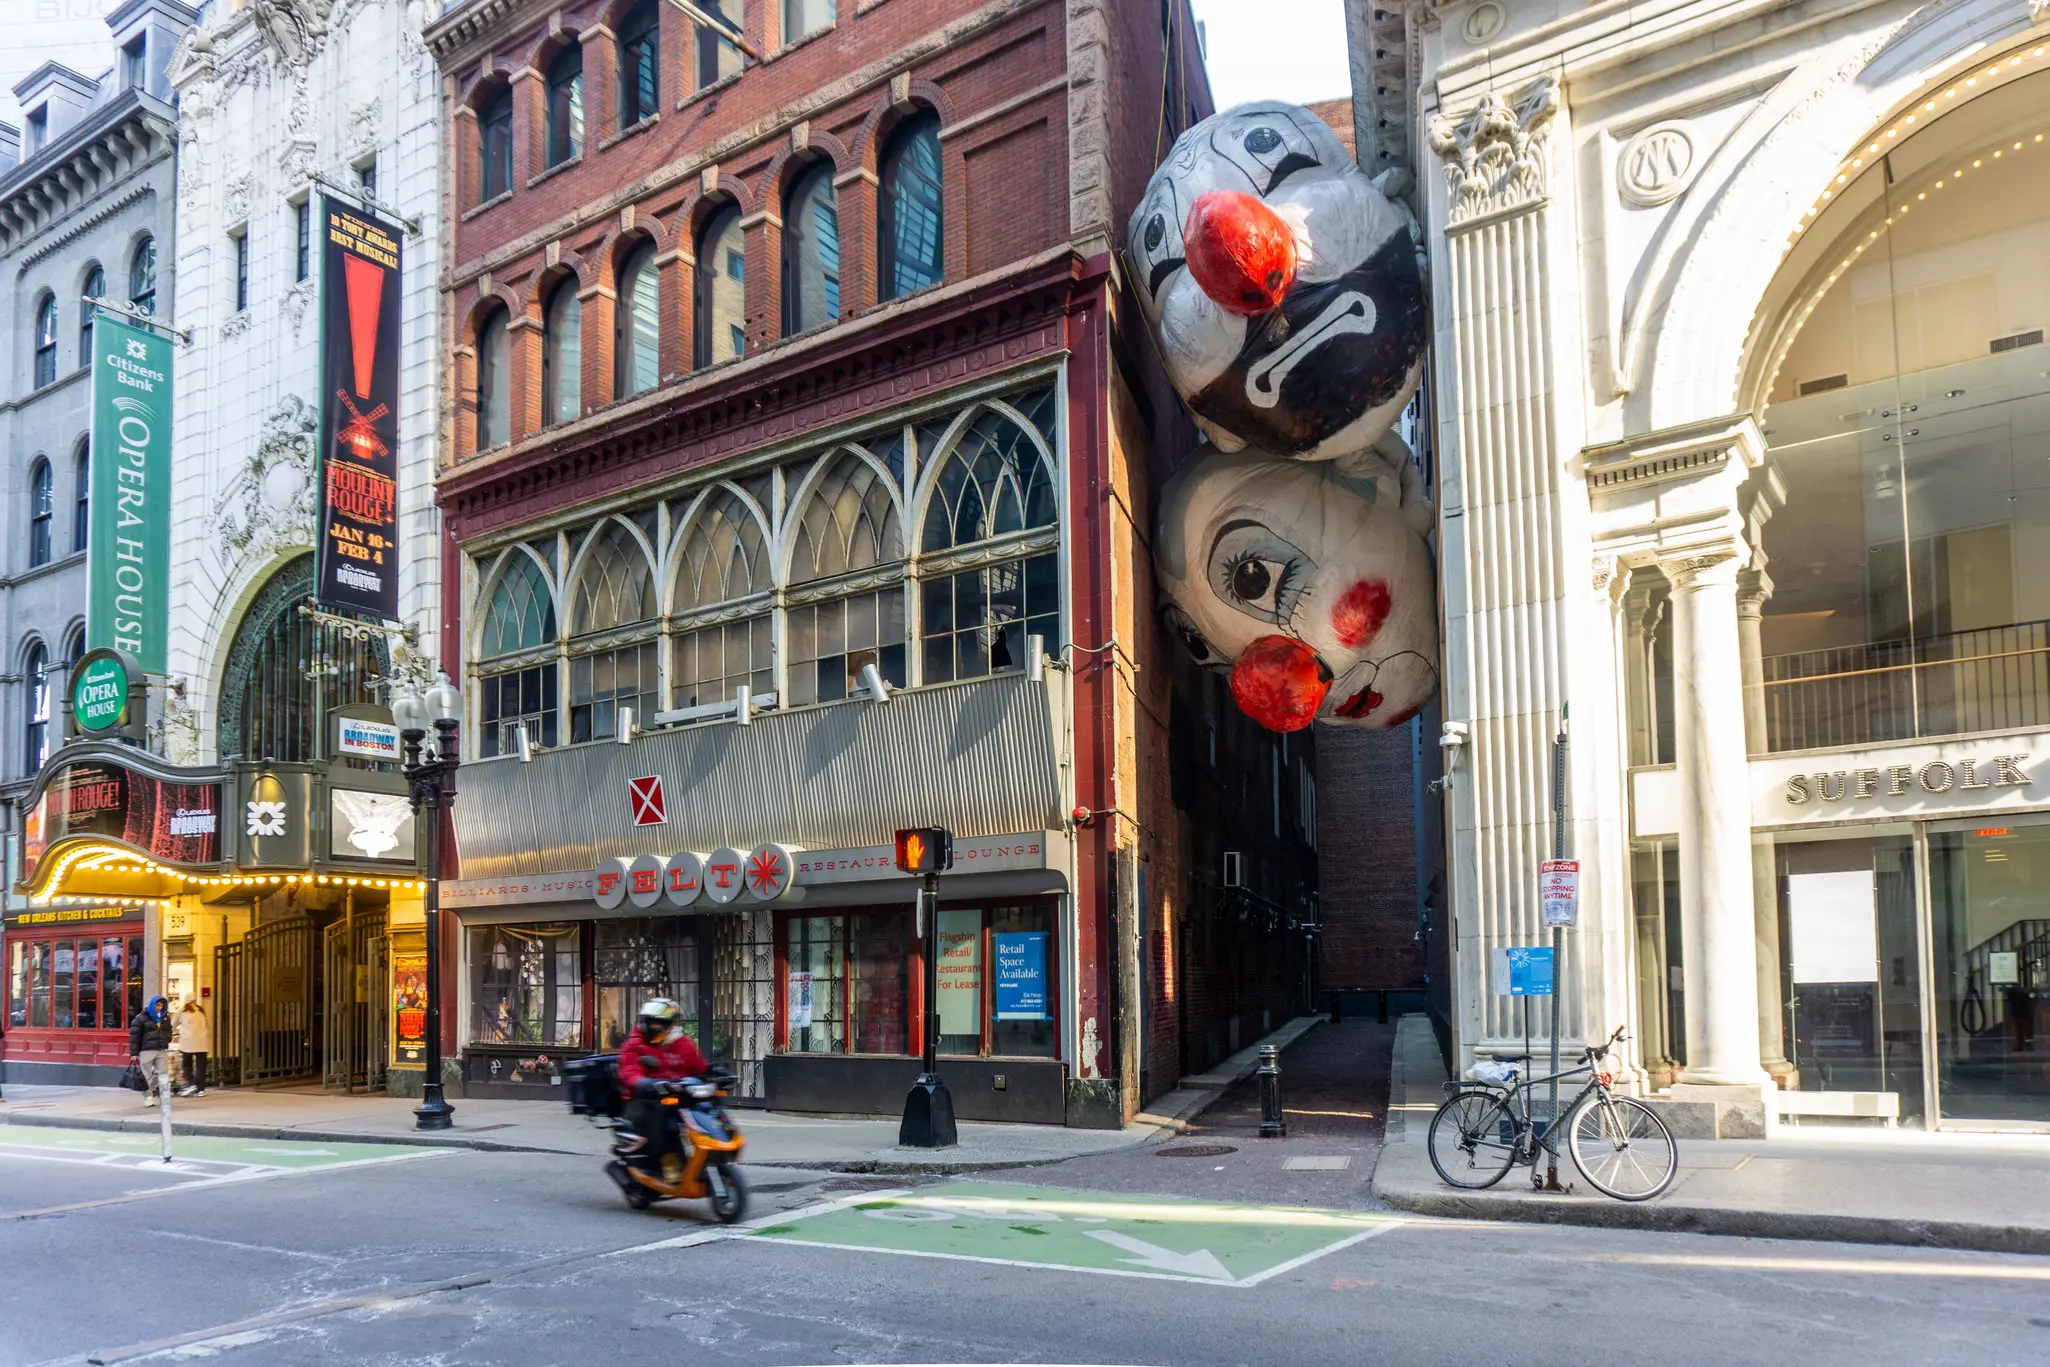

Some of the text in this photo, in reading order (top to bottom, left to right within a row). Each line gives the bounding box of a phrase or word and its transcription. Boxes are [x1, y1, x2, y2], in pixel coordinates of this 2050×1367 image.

[329, 213, 398, 254] 10 TONY AWARDS
[329, 228, 399, 270] BEST MUSICAL!
[107, 354, 164, 382] Citizens
[117, 370, 154, 393] Bank
[327, 464, 386, 502] MOULIN
[114, 415, 151, 654] OPERA HOUSE
[330, 523, 364, 543] JAN
[337, 540, 384, 565] FEB 4
[82, 682, 119, 704] OPERA
[87, 701, 116, 718] HOUSE
[344, 729, 396, 745] BROADWAY
[344, 738, 395, 752] IN BOSTON
[1786, 753, 2033, 805] SUFFOLK
[78, 782, 120, 811] ROUGE!
[800, 844, 1041, 873] RESTAUR LOUNGE
[442, 880, 594, 898] BILLIARDS MUSIC
[596, 863, 737, 896] FELT
[18, 907, 123, 924] NEW ORLEANS KITCHEN & COCKTAILS
[171, 915, 185, 928] 539
[940, 931, 976, 944] Flagship
[943, 947, 972, 958] Retail/
[999, 944, 1025, 954] Retail
[999, 957, 1025, 968] Space
[999, 968, 1039, 979] Available
[938, 980, 979, 990] For Lease
